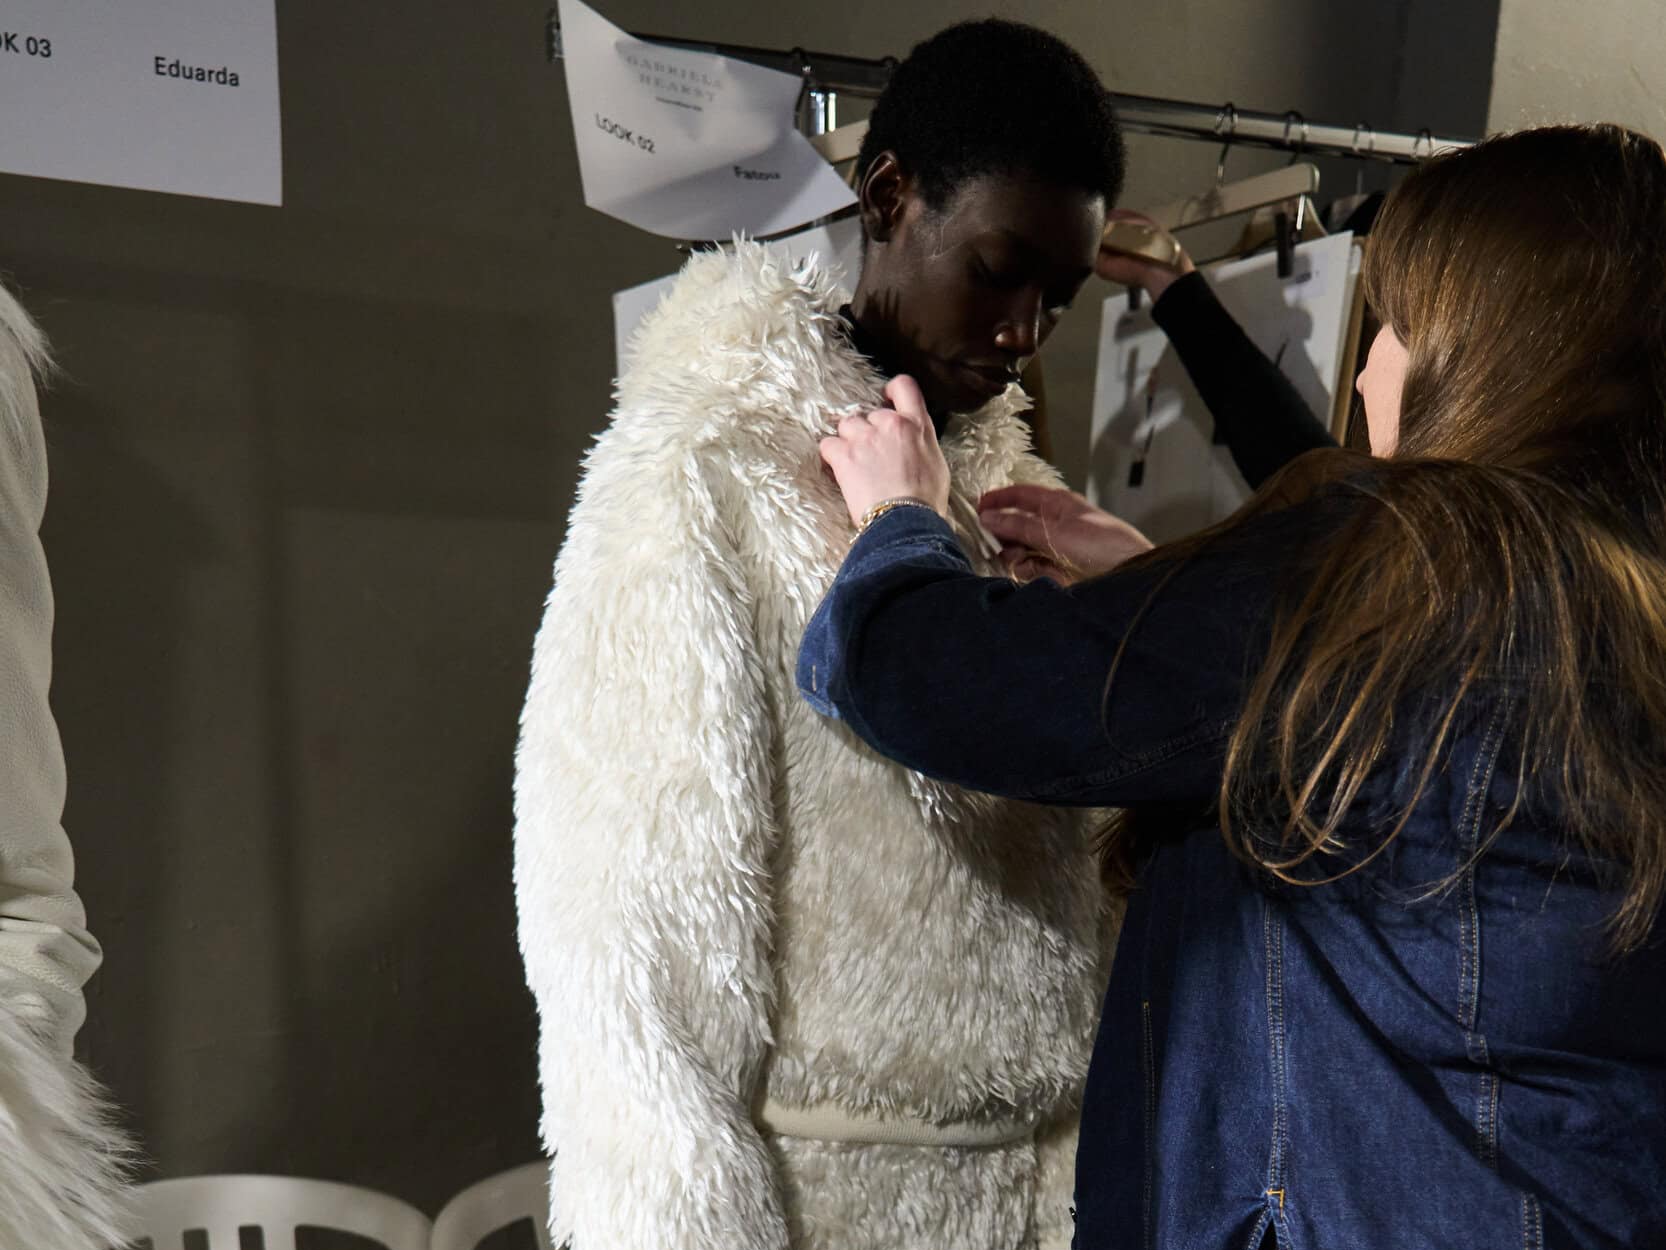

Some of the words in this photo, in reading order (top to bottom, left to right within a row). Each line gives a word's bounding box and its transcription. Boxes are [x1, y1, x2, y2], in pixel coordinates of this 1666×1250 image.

[0, 32, 20, 53] K
[26, 36, 52, 58] 03
[154, 56, 240, 87] Eduarda
[595, 112, 635, 146] LOOK
[637, 135, 656, 154] 02
